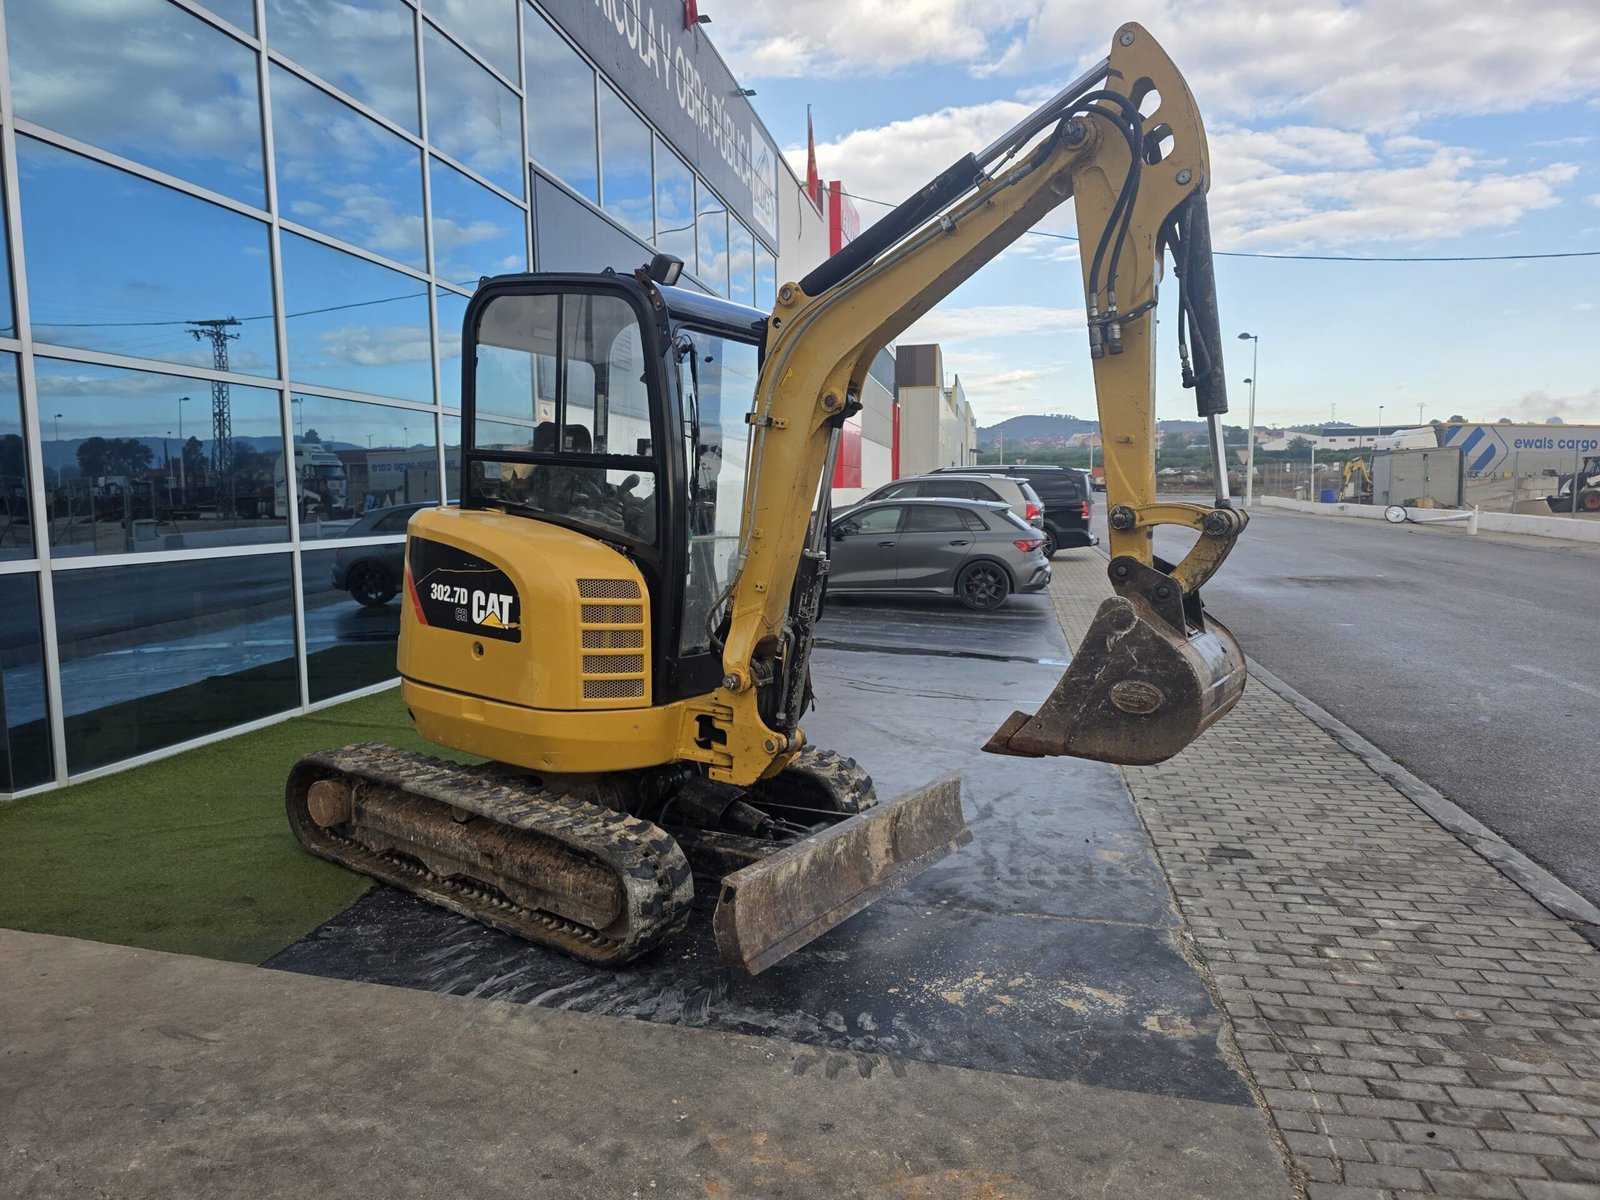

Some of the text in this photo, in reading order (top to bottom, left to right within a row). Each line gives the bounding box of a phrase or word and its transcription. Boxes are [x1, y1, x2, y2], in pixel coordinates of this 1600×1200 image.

[661, 23, 671, 91] Y
[675, 46, 711, 141] OBRA
[712, 94, 753, 192] PÚBLICA
[1514, 436, 1598, 452] ewals cargo
[430, 582, 468, 605] 302.7D
[455, 607, 468, 622] CR
[472, 589, 514, 630] CAT
